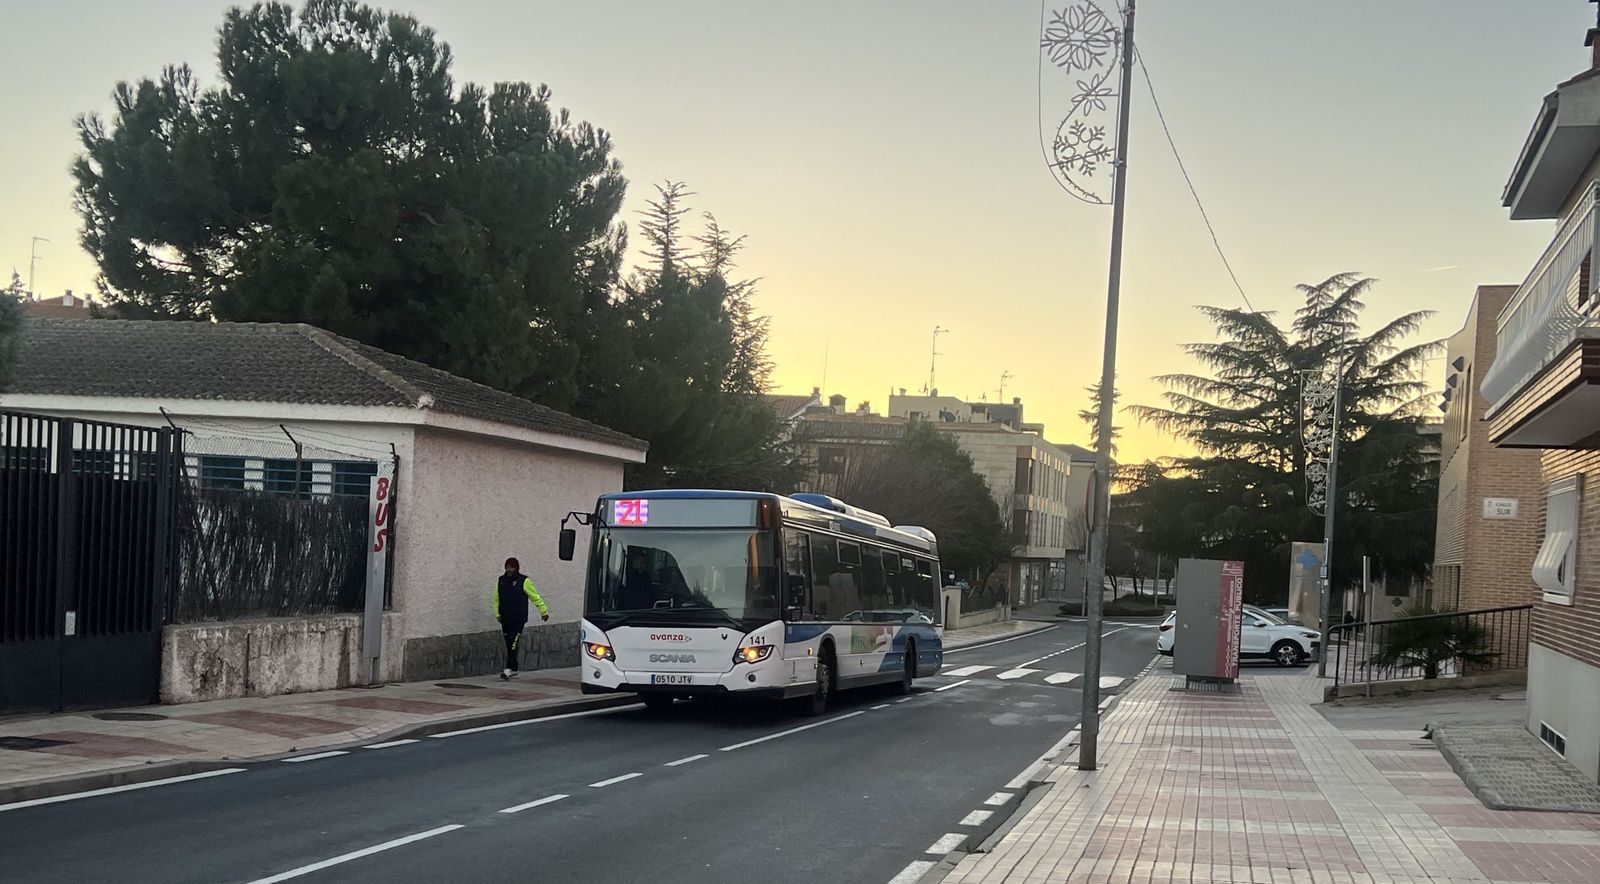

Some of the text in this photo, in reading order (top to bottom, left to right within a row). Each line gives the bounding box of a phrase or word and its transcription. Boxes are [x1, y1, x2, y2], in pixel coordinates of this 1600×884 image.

[374, 477, 389, 553] BUS
[619, 499, 642, 524] 21
[1496, 508, 1511, 516] SUR
[750, 636, 765, 645] 141
[1232, 614, 1241, 667] TRANSPORTE
[649, 654, 696, 663] SCANIA
[656, 675, 693, 684] 0510 JTV
